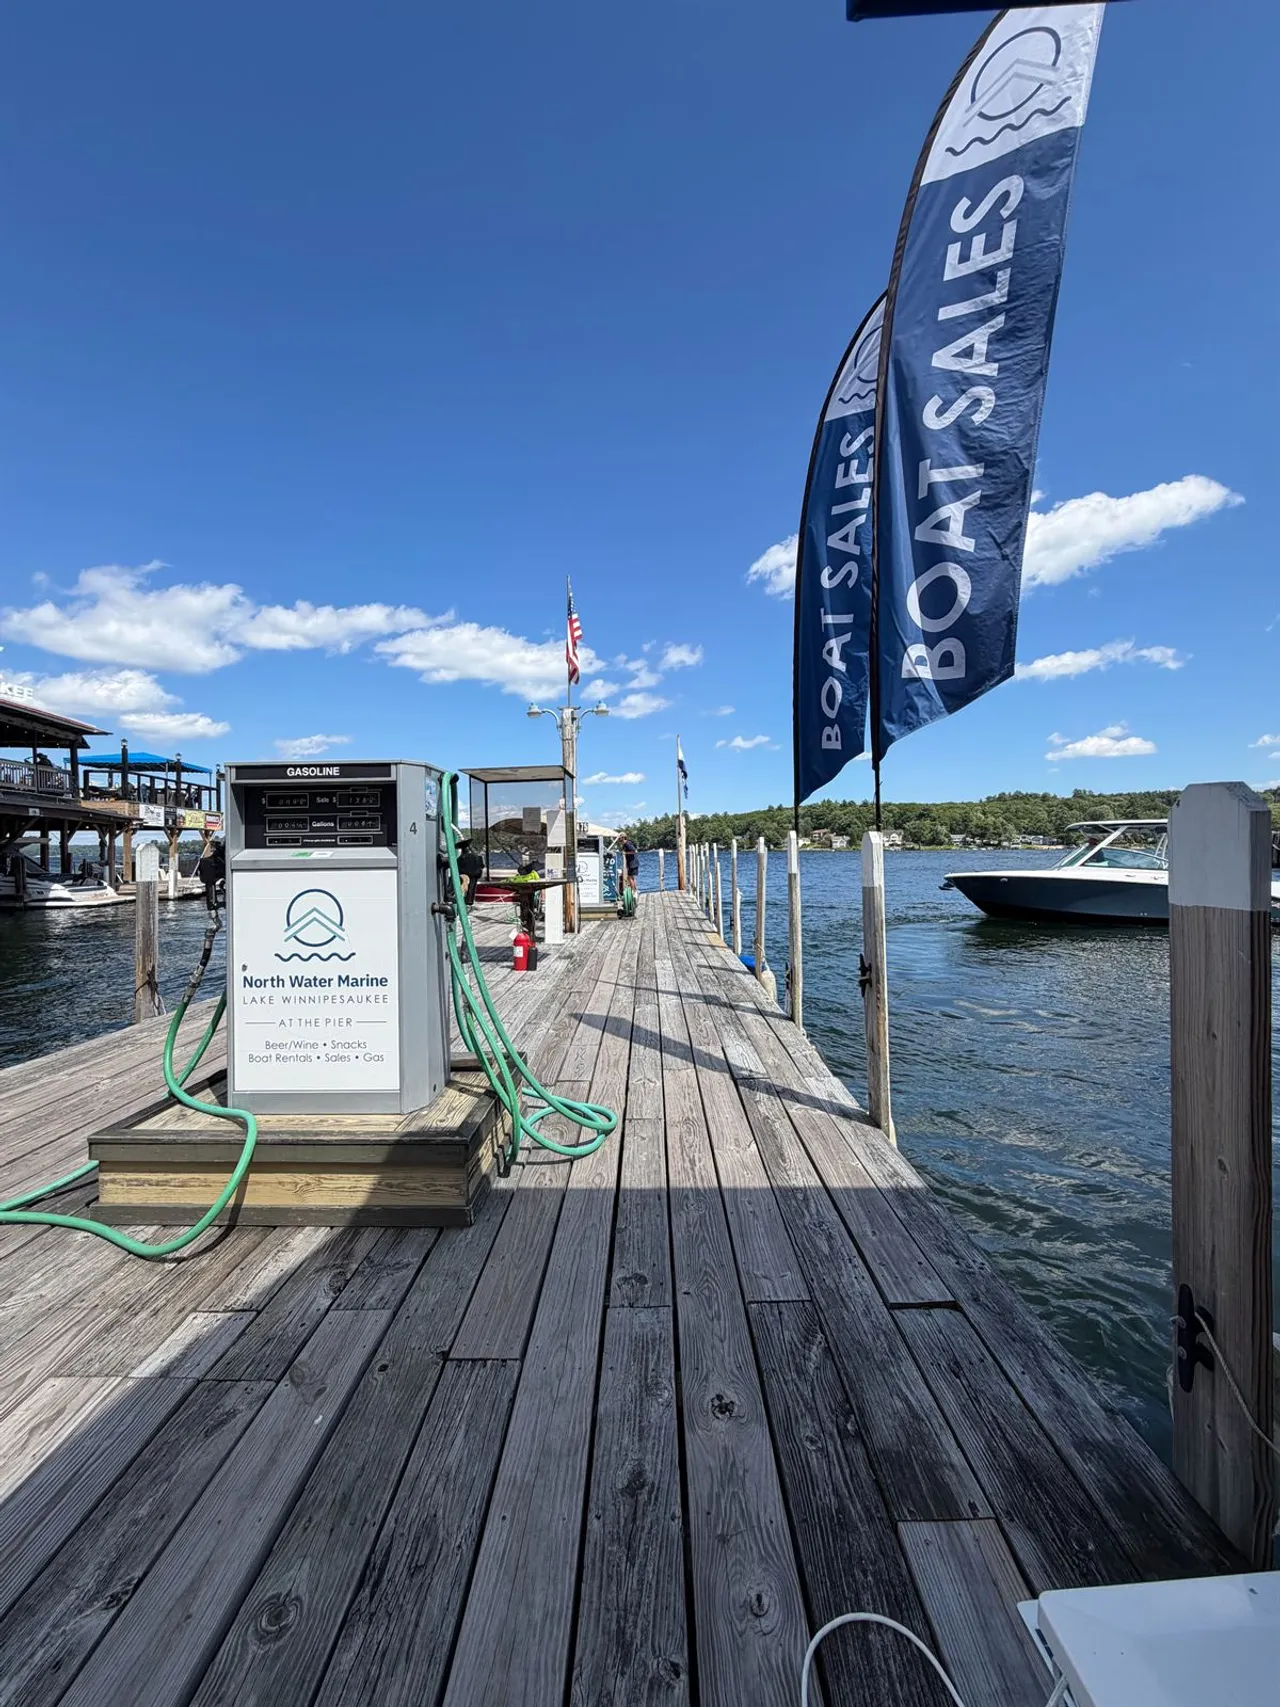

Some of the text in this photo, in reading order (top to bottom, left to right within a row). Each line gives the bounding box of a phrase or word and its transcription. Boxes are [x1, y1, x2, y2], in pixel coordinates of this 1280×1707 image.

[901, 174, 1025, 681] BOAT SALES
[820, 425, 874, 750] BOAT SALES
[286, 766, 340, 776] GASOLINE
[316, 796, 330, 804] Sale
[409, 822, 418, 835] 4
[243, 974, 388, 988] North Water Marine
[243, 994, 388, 1005] LAKE WINNIPESAUKEE
[278, 1018, 352, 1028] AT THE PIER
[265, 1040, 367, 1050] Beer/Wine Snacks
[248, 1053, 385, 1063] Boat Rentals Sales Gas
